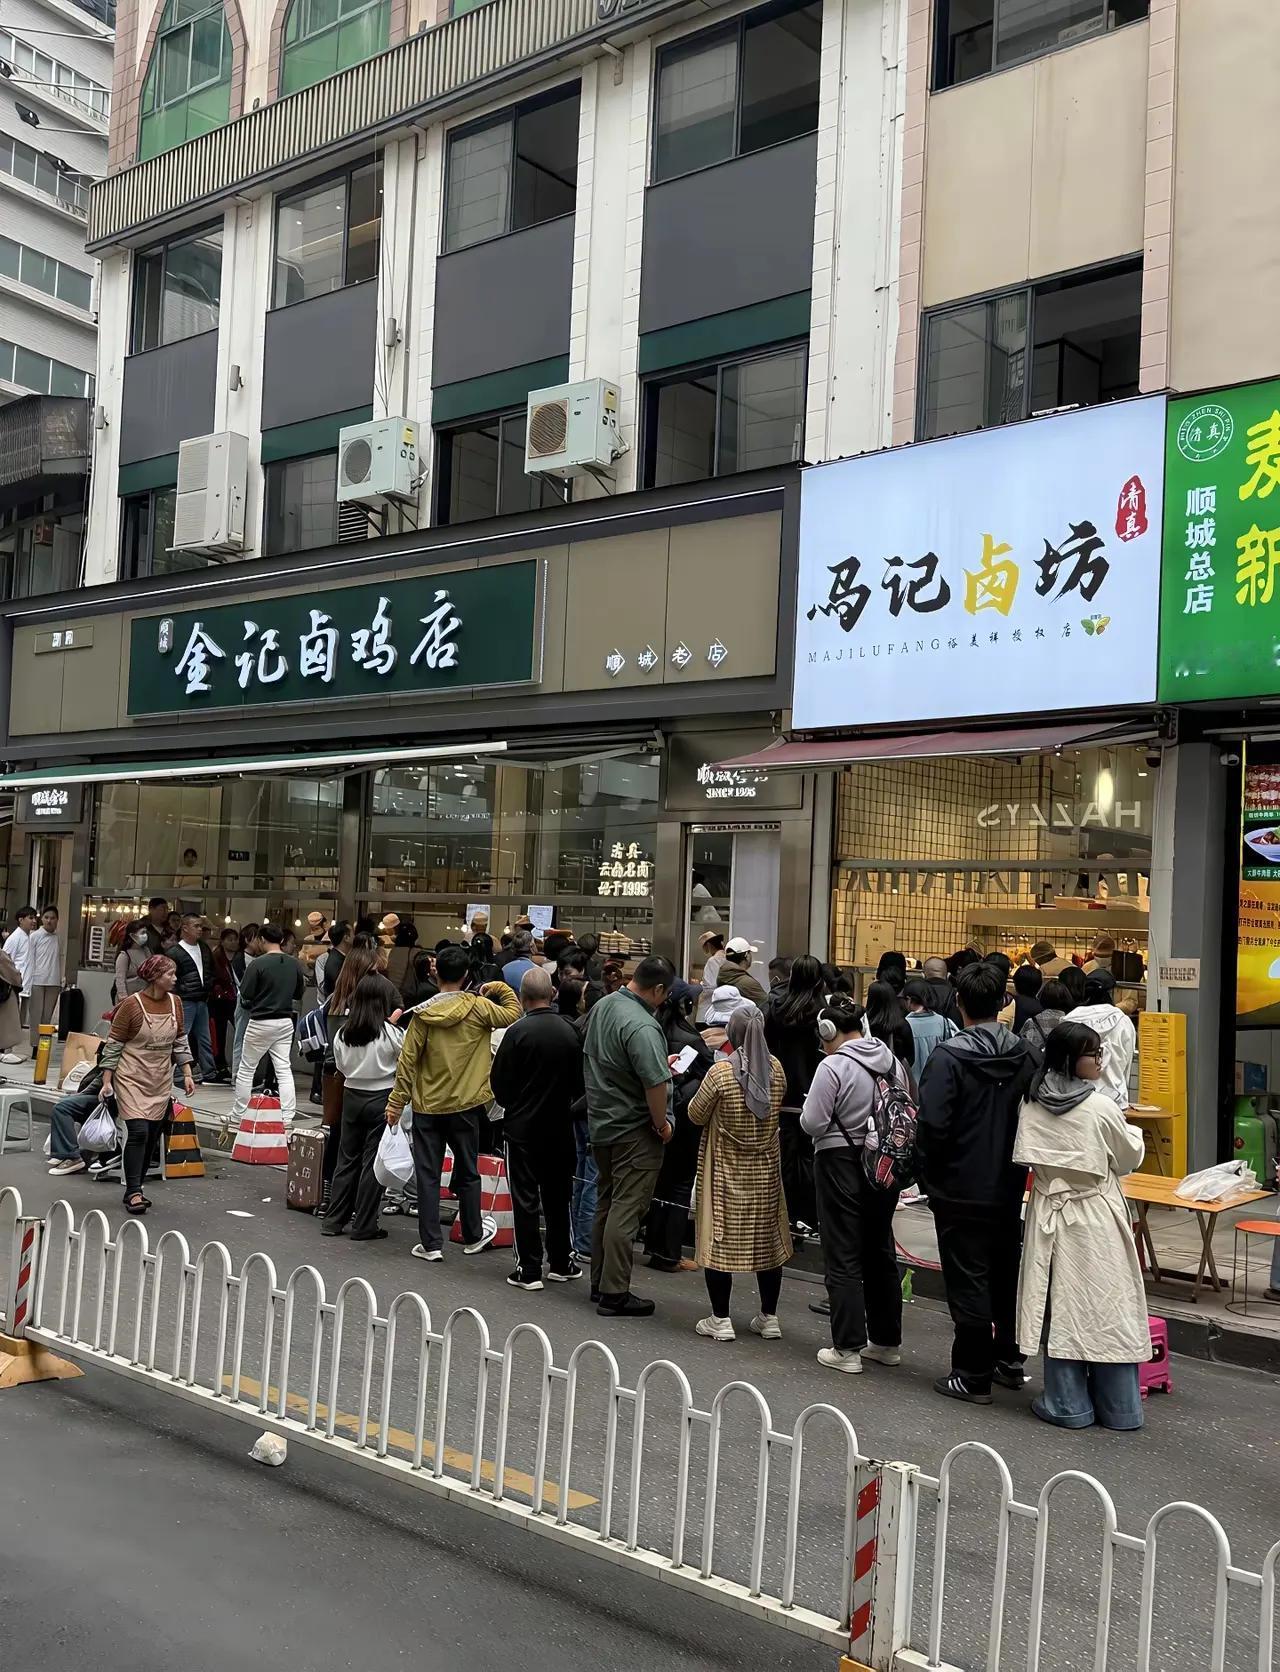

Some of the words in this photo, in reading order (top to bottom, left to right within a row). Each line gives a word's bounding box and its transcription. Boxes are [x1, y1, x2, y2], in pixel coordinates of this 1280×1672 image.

[1119, 481, 1143, 539] 清真
[1182, 484, 1217, 614] 顺城总店
[806, 519, 1110, 633] 马记卤坊
[1235, 523, 1280, 607] 新
[174, 588, 463, 696] 金记卤鸡店
[808, 639, 940, 663] MAJILUFANG
